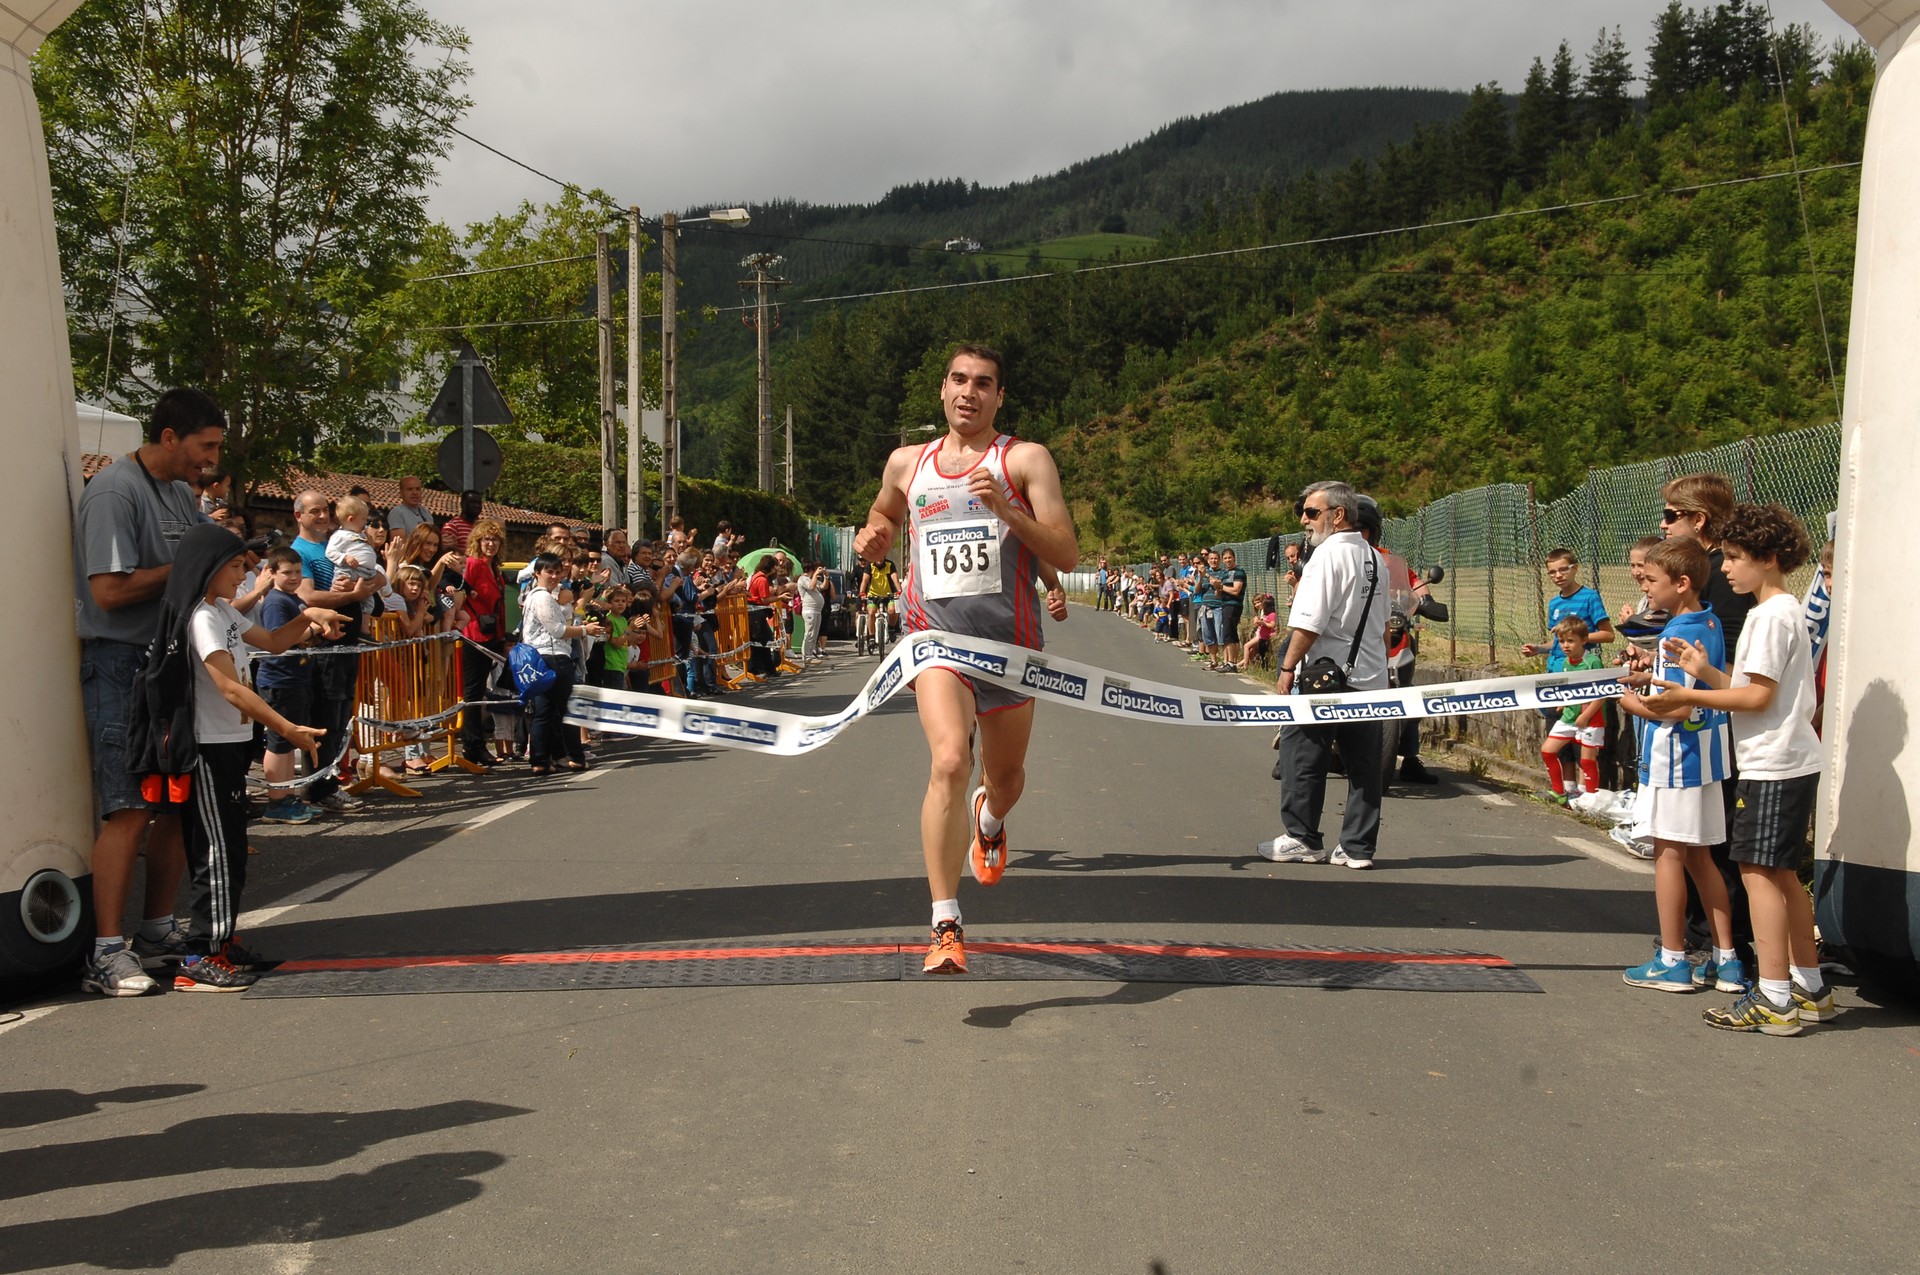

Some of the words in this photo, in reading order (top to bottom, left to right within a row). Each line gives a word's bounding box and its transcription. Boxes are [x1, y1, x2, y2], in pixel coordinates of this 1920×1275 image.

[918, 499, 948, 514] FRANCISCO
[920, 503, 949, 519] ALBERDI
[929, 529, 985, 544] Gipuzkoa
[930, 543, 989, 575] 1635
[914, 641, 1005, 675] Gipuzkoa
[1025, 665, 1084, 697] Gipuzkoa
[1104, 686, 1181, 716] Gipuzkoa
[1539, 682, 1625, 702] Gipuzkoa
[1315, 703, 1404, 720] Gipuzkoa
[1427, 694, 1516, 713] Gipuzkoa
[1204, 704, 1292, 723] Gipuzkoa
